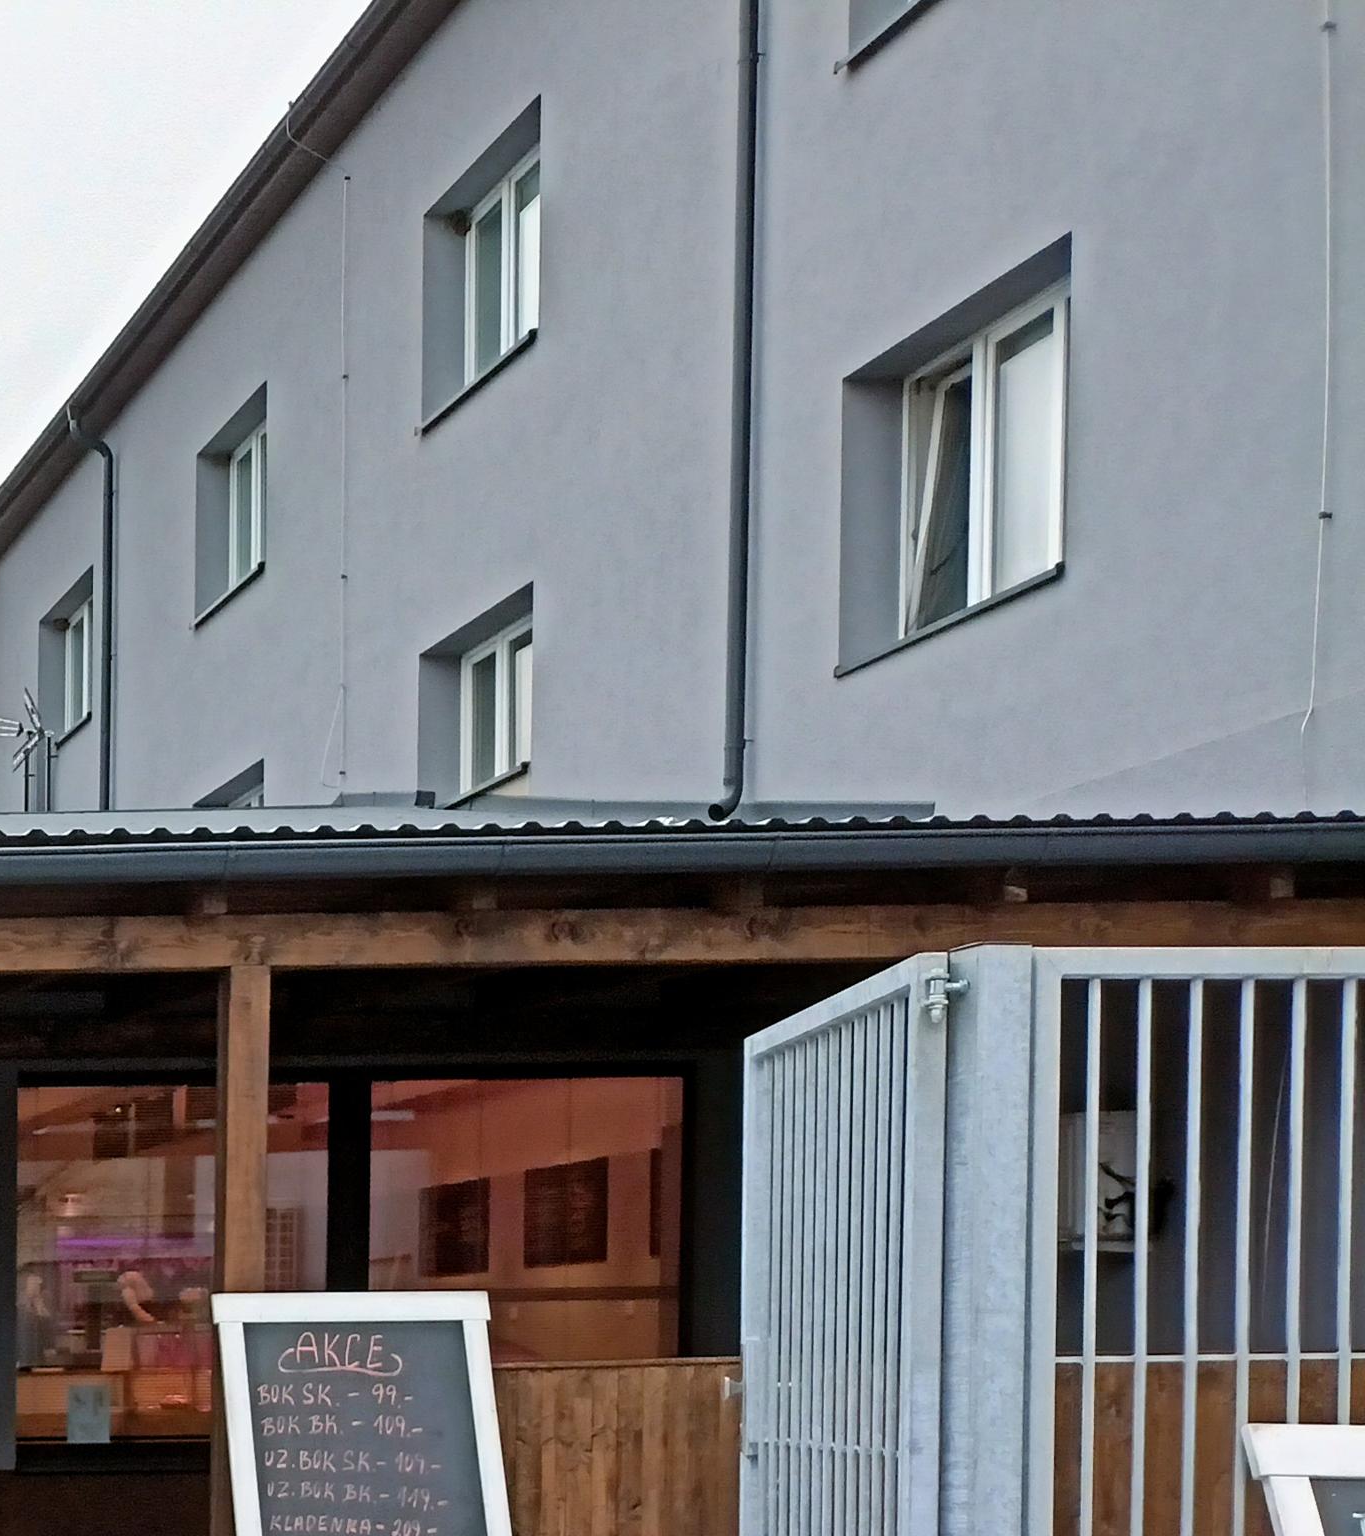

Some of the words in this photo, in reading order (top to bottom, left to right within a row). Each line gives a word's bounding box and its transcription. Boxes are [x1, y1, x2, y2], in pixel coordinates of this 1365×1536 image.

[297, 1331, 383, 1369] AKCE
[257, 1384, 295, 1406] BOK
[261, 1415, 301, 1436] BOK
[299, 1449, 336, 1472] BOK
[300, 1481, 335, 1501] BOK
